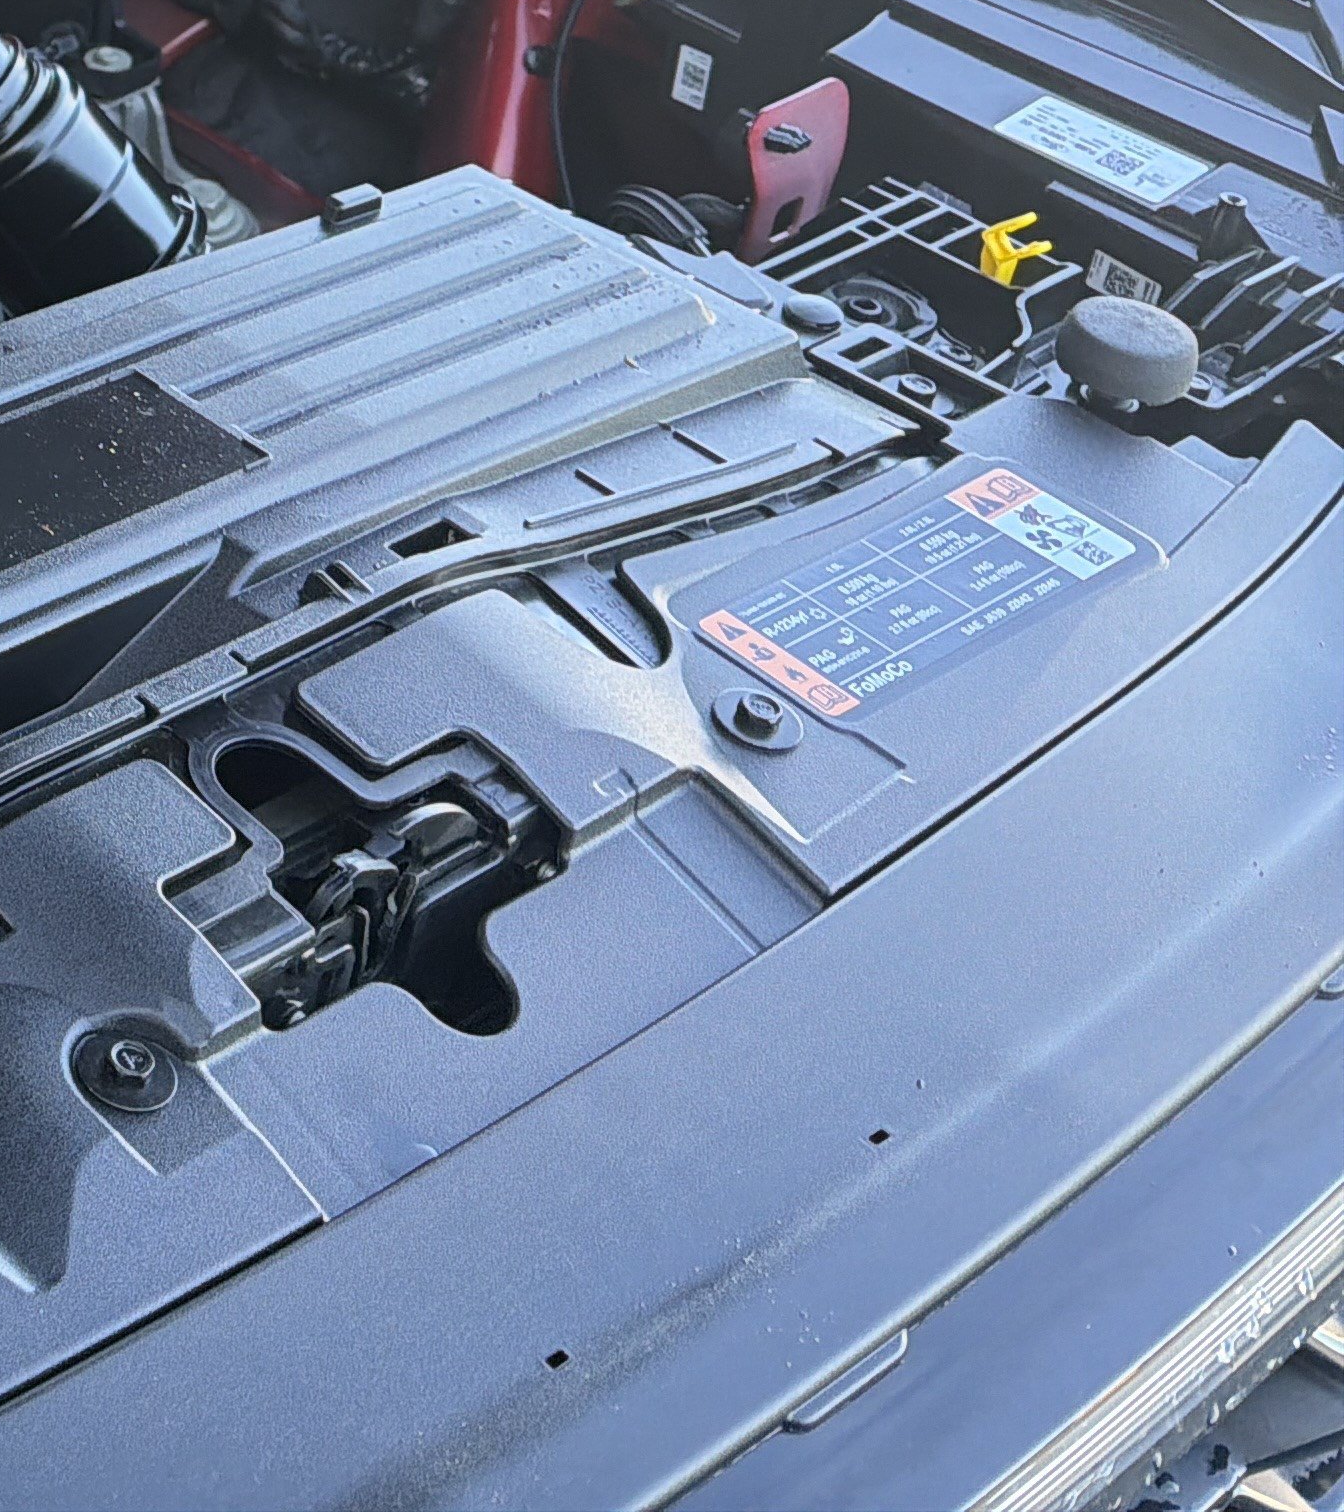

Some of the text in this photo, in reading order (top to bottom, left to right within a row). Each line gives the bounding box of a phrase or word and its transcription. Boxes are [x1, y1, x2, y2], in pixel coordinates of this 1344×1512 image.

[971, 559, 995, 575] PAG
[889, 602, 912, 618] PAG
[806, 647, 838, 668] PAG
[848, 658, 914, 698] FoMoCo
